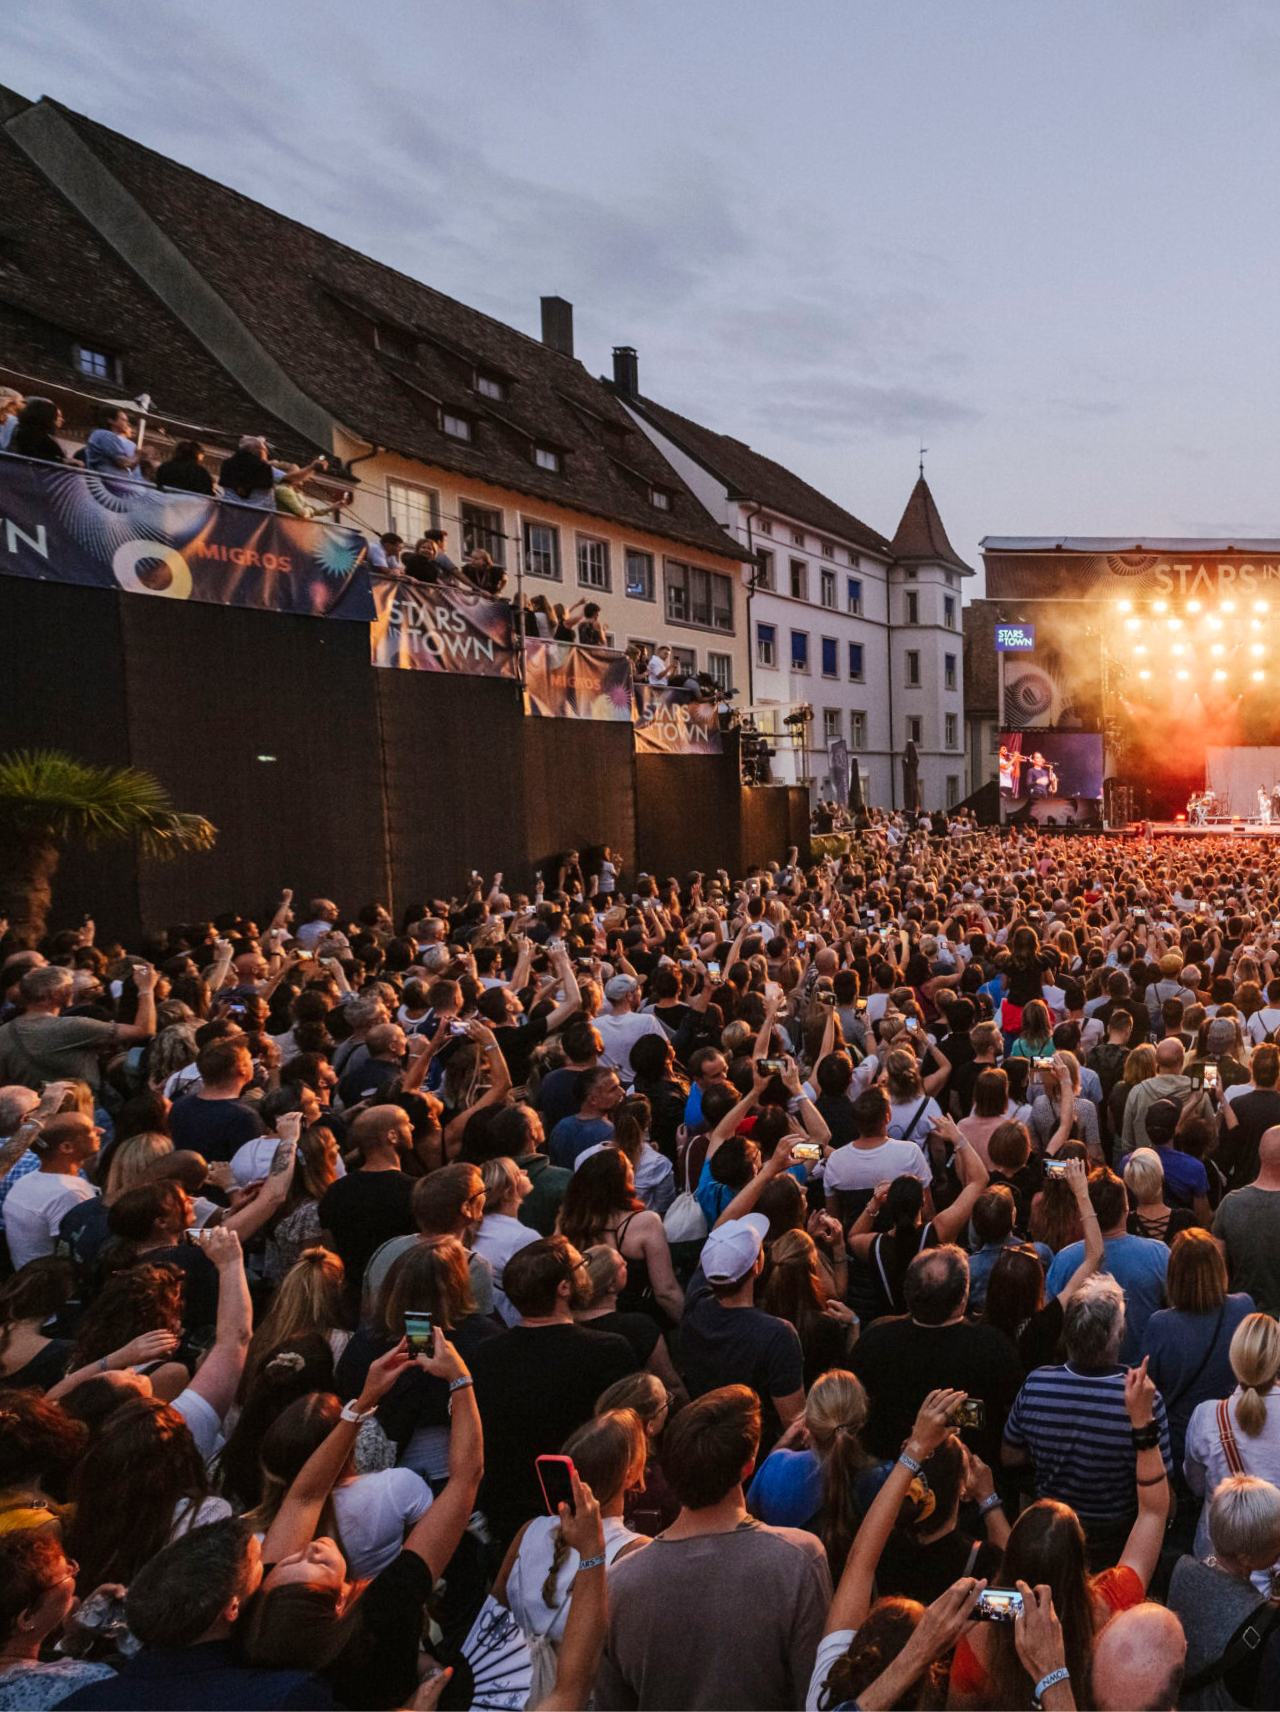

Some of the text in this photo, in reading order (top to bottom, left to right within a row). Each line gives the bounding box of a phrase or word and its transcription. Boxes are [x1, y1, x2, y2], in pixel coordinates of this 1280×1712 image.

[199, 542, 292, 573] MIGROS
[1154, 564, 1258, 595] STARS
[1263, 565, 1280, 580] IN
[388, 600, 466, 633] STARS
[998, 630, 1023, 638] STARS
[1004, 638, 1032, 646] TOWN
[406, 628, 494, 662] TOWN
[549, 674, 602, 691] MIGROS
[643, 702, 690, 722] STARS
[654, 722, 708, 742] TOWN
